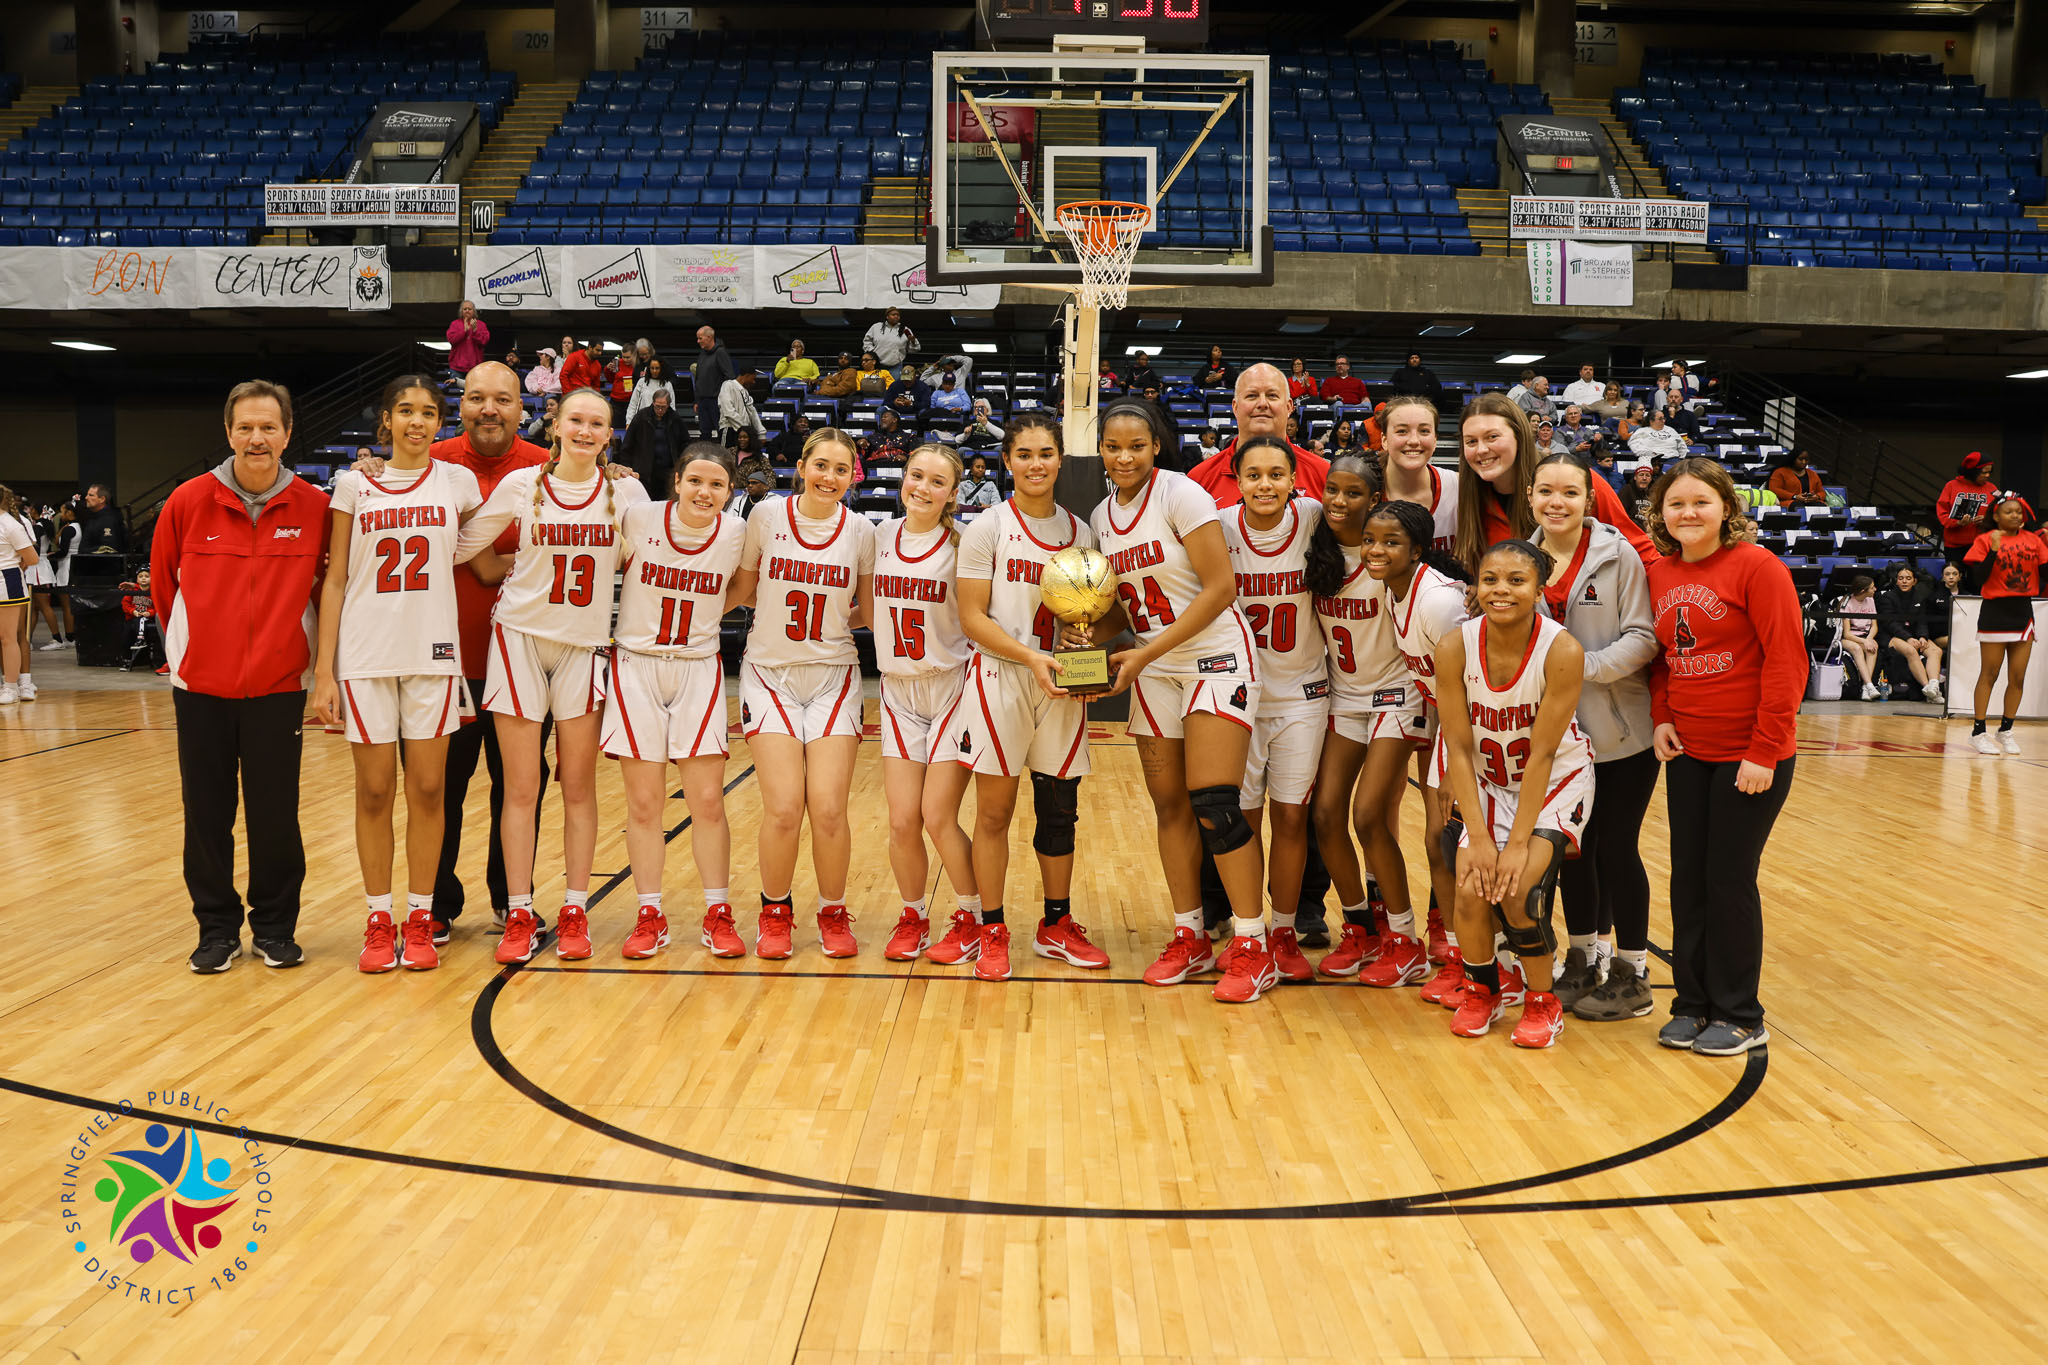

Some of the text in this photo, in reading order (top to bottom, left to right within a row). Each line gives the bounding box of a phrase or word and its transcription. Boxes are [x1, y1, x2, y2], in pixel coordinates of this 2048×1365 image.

[191, 13, 215, 29] 310
[643, 10, 667, 26] 311
[525, 33, 549, 49] 209
[1549, 129, 1589, 137] CENTER
[400, 142, 415, 154] EXIT
[977, 145, 993, 156] EXIT
[1557, 157, 1573, 169] EXIT
[267, 189, 326, 201] SPORTS RADIO
[331, 189, 390, 201] SPORTS RADIO
[395, 189, 456, 201] SPORTS RADIO
[267, 202, 326, 213] 92.3FM/1450AM
[331, 201, 390, 213] 92.3FM/1450AM
[395, 201, 456, 213] 92.3FM/1450AM
[1513, 201, 1574, 214] SPORTS RADIO
[1579, 203, 1641, 216] SPORTS RADIO
[1645, 205, 1706, 218] SPORTS RADIO
[474, 205, 491, 230] 110
[1513, 214, 1574, 226] 92.3FM/1450AM
[1579, 216, 1641, 228] 92.3FM/1450AM
[1645, 218, 1705, 231] 92.3FM/1450AM
[88, 249, 340, 296] B.O.N CENTER
[488, 269, 541, 290] BROOKLYN
[789, 268, 828, 288] ZHARI
[1532, 242, 1540, 302] SECTION
[1545, 242, 1553, 302] SPONSOR
[1592, 267, 1631, 275] STEPHENS
[588, 270, 639, 291] HARMONY
[360, 505, 447, 535] SPRINGFIELD
[376, 535, 430, 593] 22
[769, 556, 851, 589] SPRINGFIELD
[549, 554, 596, 607] 13
[640, 561, 723, 595] SPRINGFIELD
[875, 574, 948, 603] SPRINGFIELD
[1117, 575, 1176, 634] 24
[655, 596, 694, 646] 11
[785, 590, 827, 643] 31
[889, 606, 926, 660] 15
[1031, 601, 1055, 652] 4
[1246, 602, 1298, 653] 20
[1331, 625, 1357, 674] 3
[1058, 656, 1103, 668] City Tournament
[1665, 651, 1734, 676] NATORS
[1067, 670, 1096, 680] Champions
[1480, 737, 1531, 787] 33
